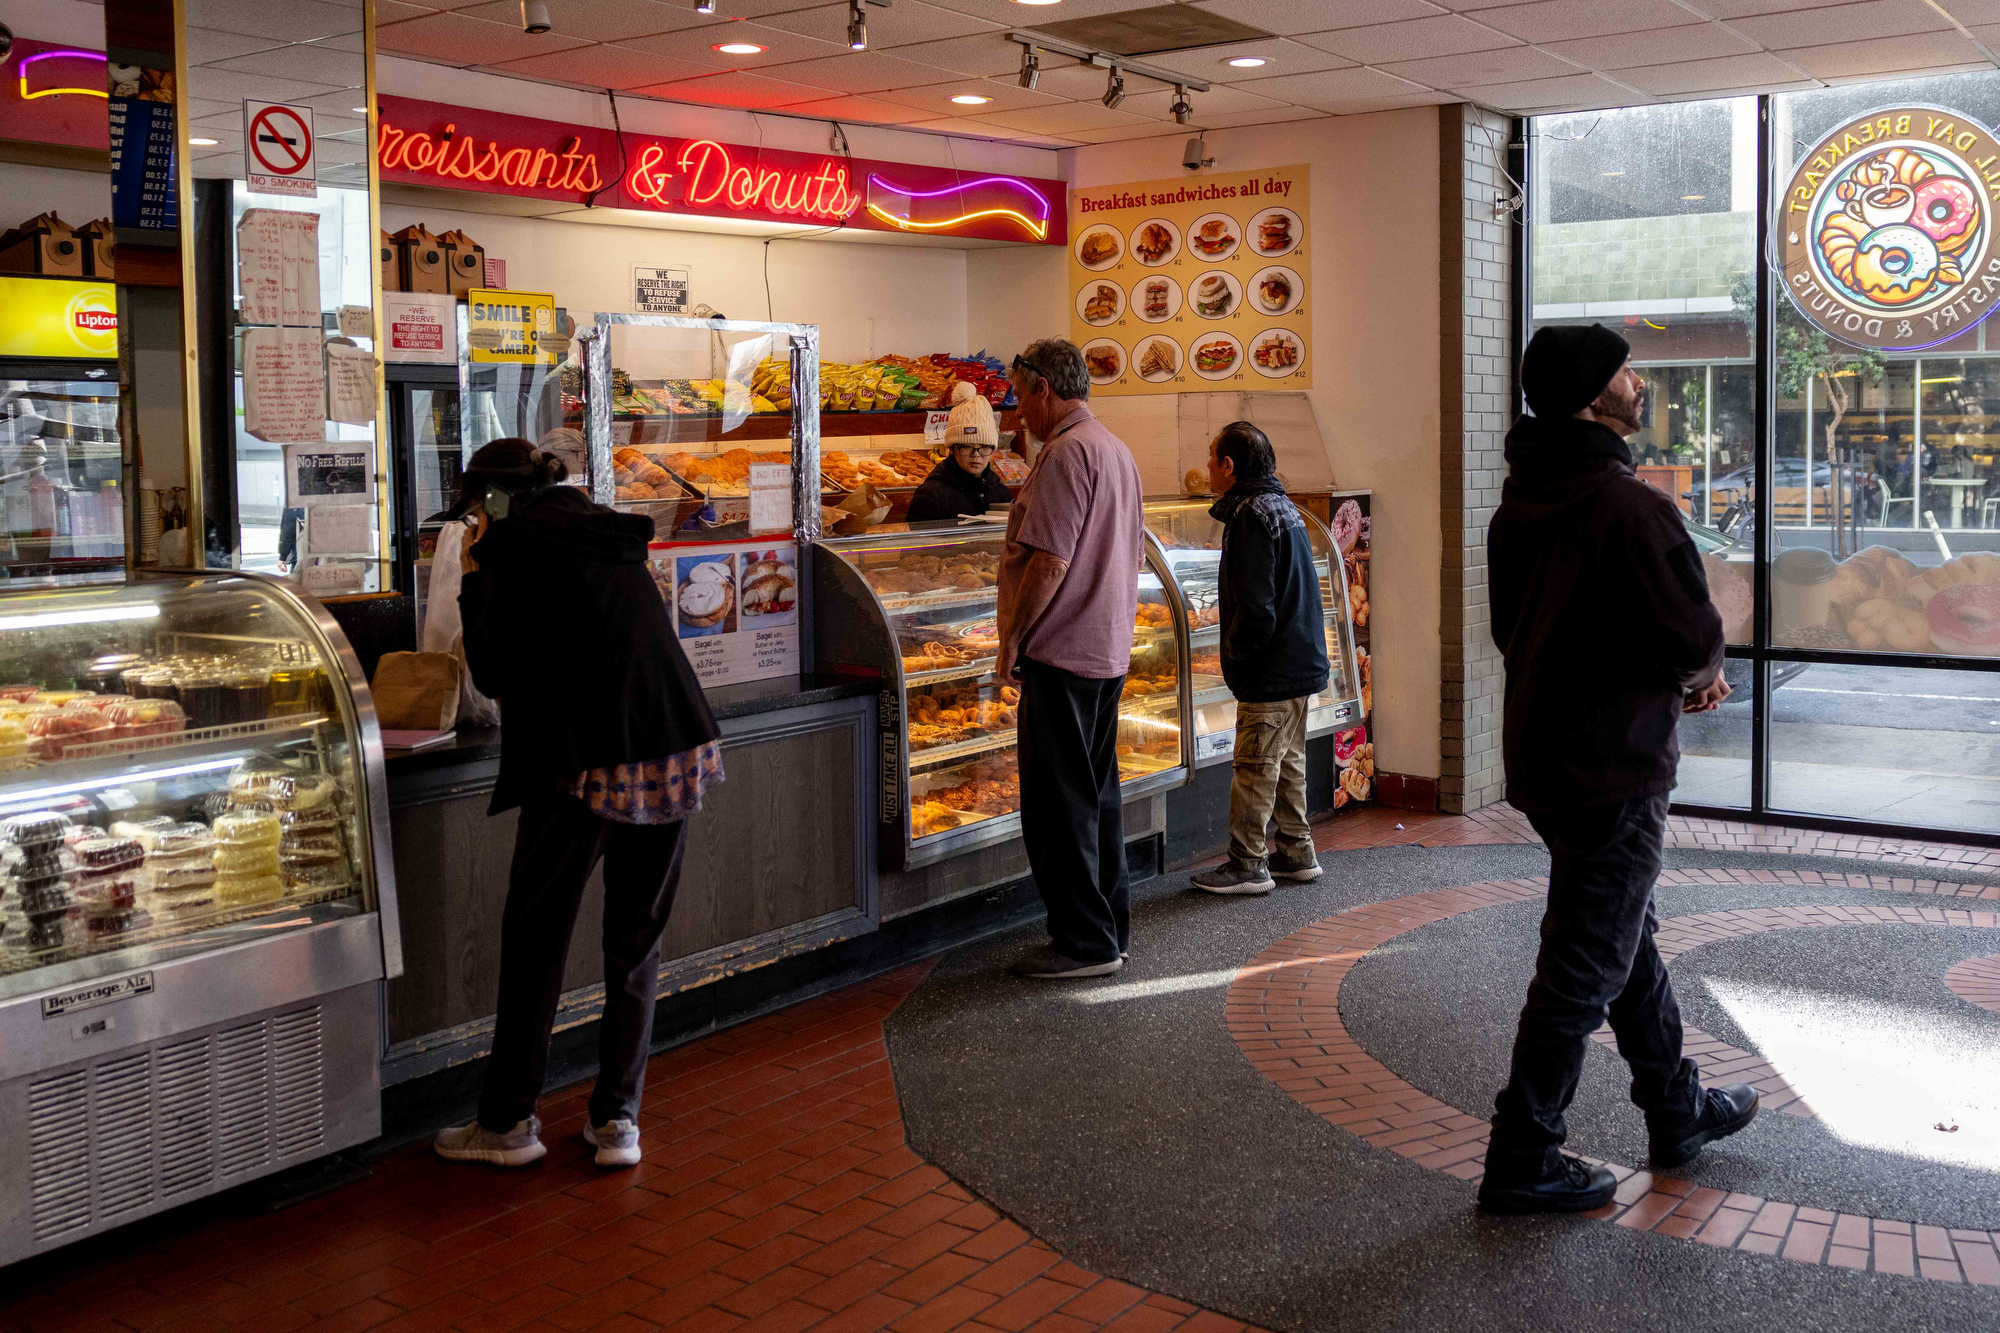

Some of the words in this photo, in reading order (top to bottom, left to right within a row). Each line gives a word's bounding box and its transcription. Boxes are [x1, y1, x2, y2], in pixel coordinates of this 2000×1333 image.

[378, 123, 603, 193] roissants
[631, 145, 673, 205] &
[677, 139, 860, 216] Donuts
[250, 176, 266, 186] NO
[270, 178, 316, 190] SMOKING
[1081, 193, 1147, 213] Breakfast
[1150, 183, 1236, 206] sandwiches
[1240, 179, 1260, 197] all
[1264, 178, 1292, 198] day
[656, 270, 668, 280] WE
[638, 278, 660, 288] RESERVE
[661, 280, 670, 288] THE
[671, 280, 686, 290] RIGHT
[654, 289, 681, 297] REFUSE
[648, 296, 676, 304] SERVICE
[474, 302, 531, 323] SMILE
[653, 304, 682, 312] ANYONE
[78, 314, 118, 328] Lipton
[400, 314, 436, 323] RESERVE
[411, 325, 430, 333] RIGHT
[496, 328, 524, 340] U'RE
[418, 332, 442, 341] SERVICE
[298, 456, 311, 468] NO
[312, 456, 333, 468] FREE
[334, 454, 365, 467] REFILLS
[308, 570, 322, 580] NO
[757, 632, 772, 641] Bagel
[694, 640, 712, 649] Bagel
[882, 690, 891, 726] MAVEN
[891, 695, 899, 722] STP
[884, 732, 896, 754] ALL
[884, 758, 896, 787] TAKE
[884, 789, 897, 823] MUST
